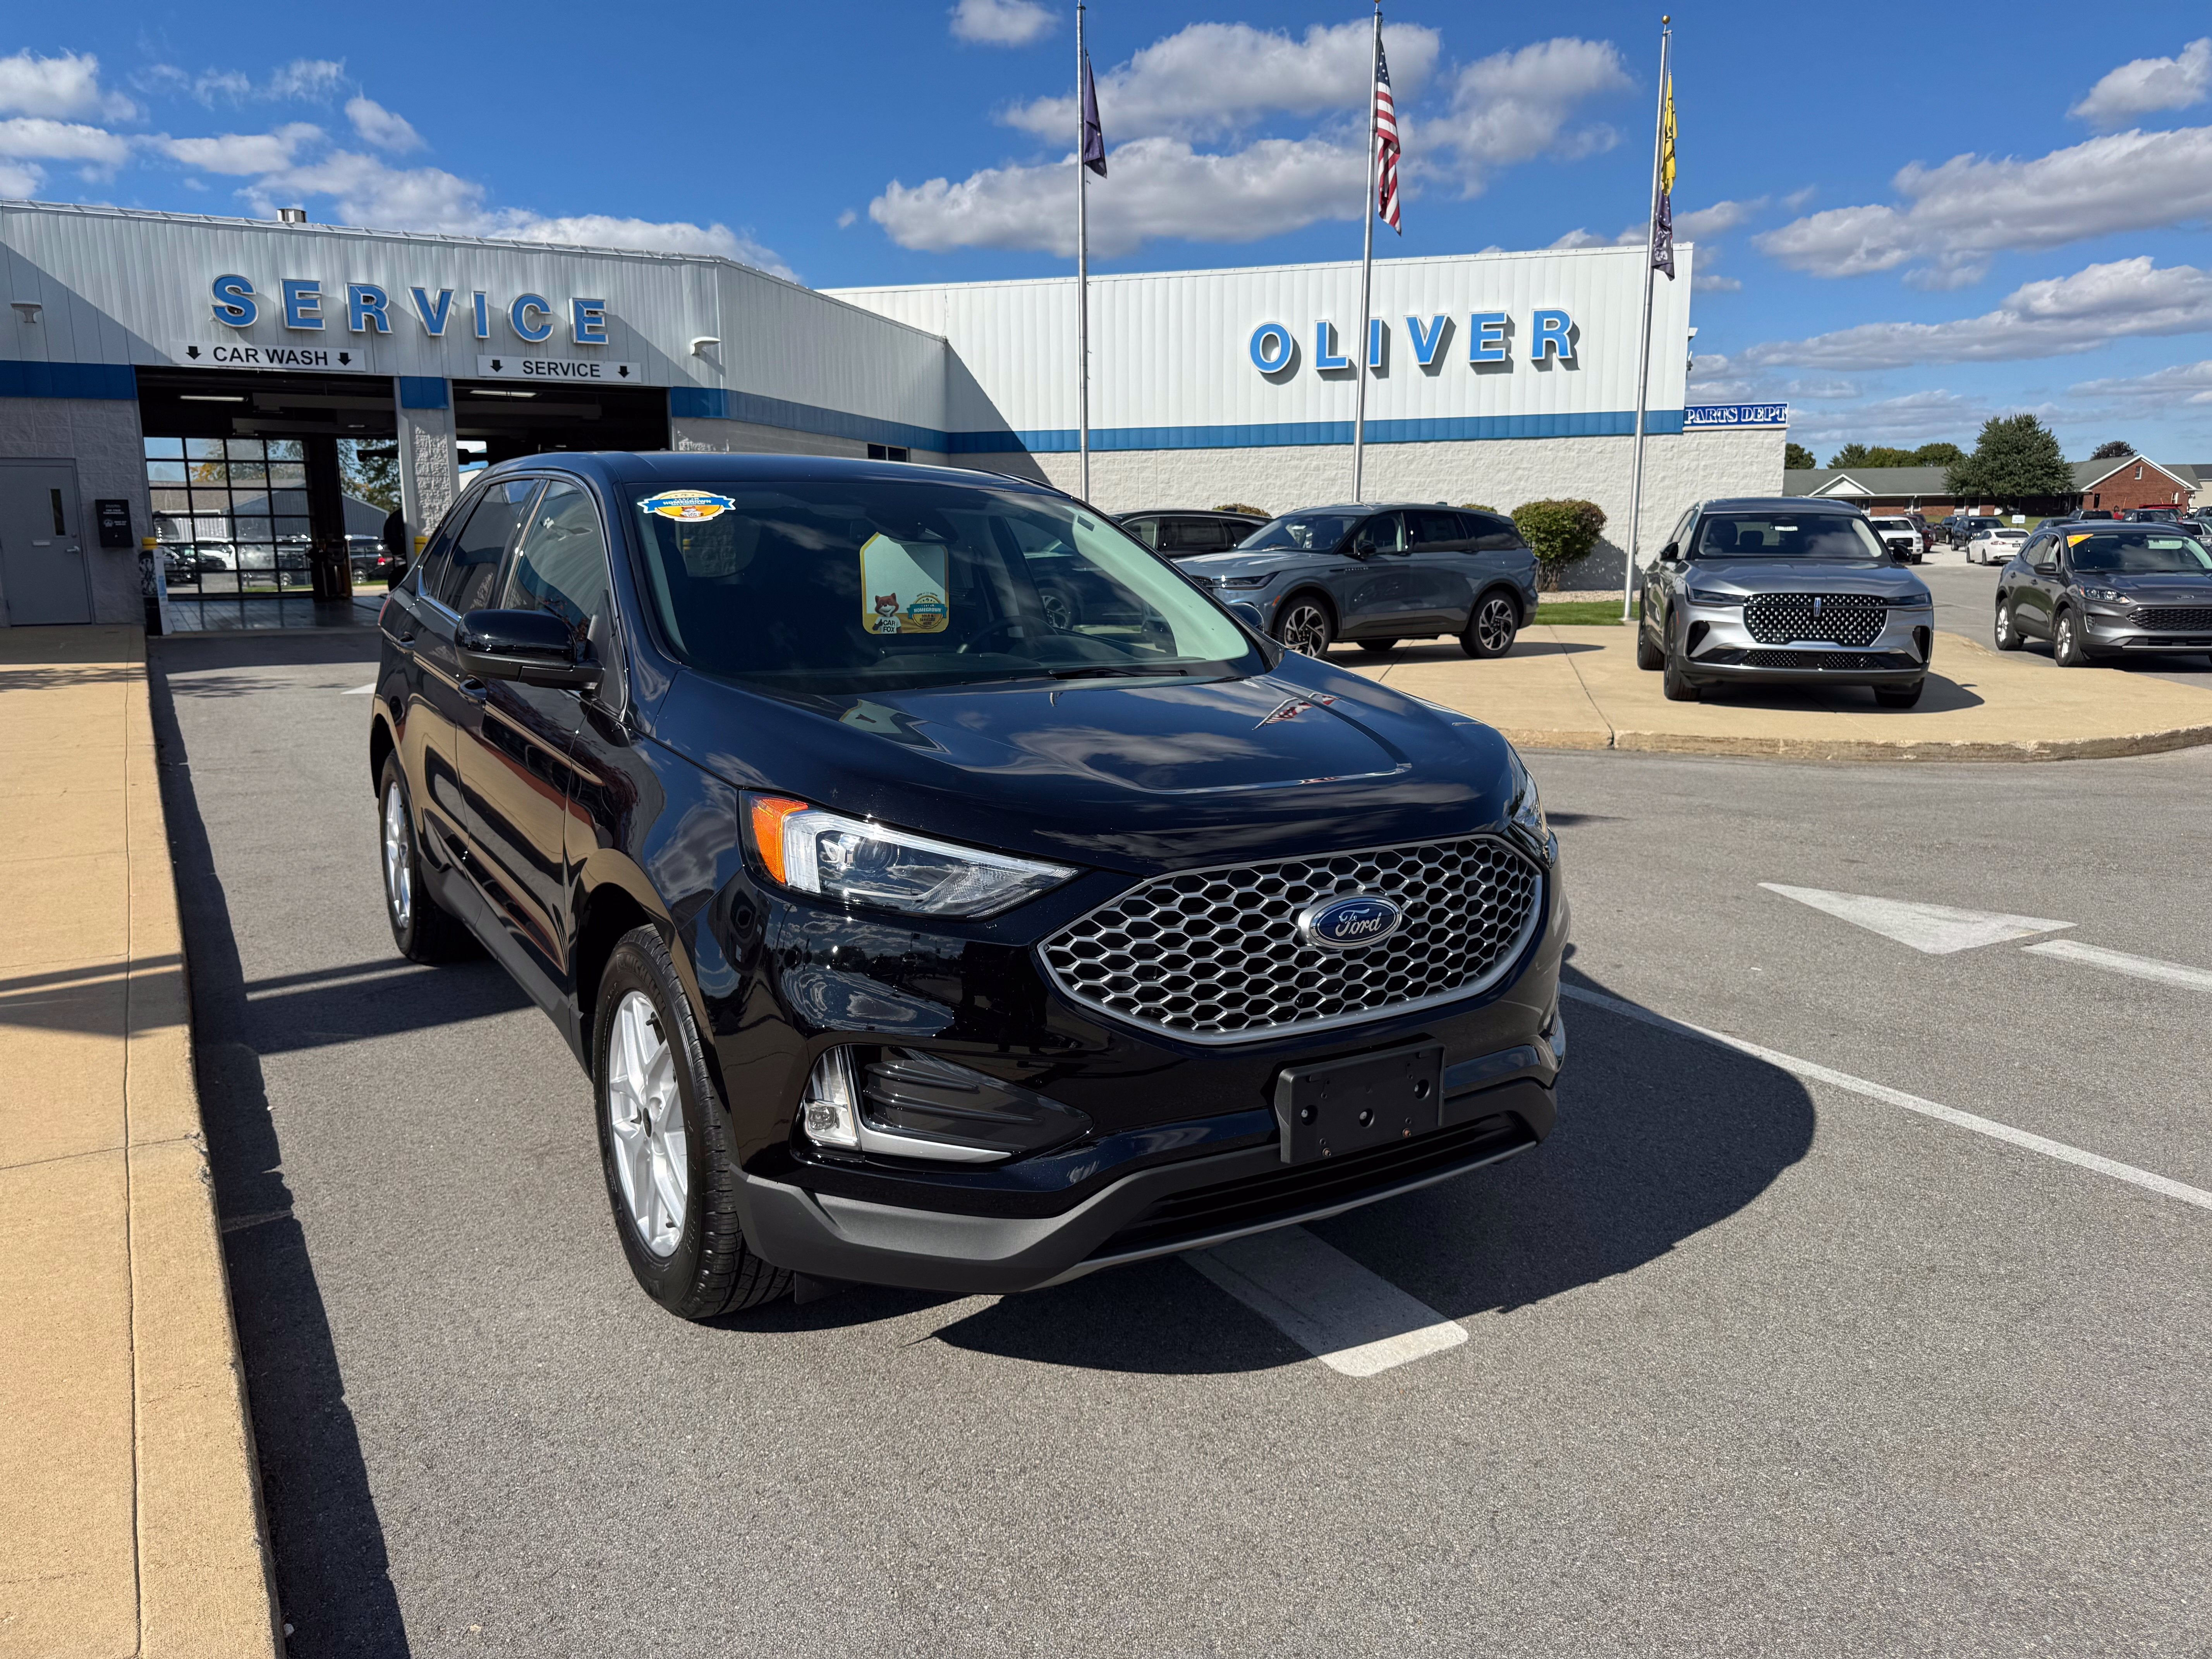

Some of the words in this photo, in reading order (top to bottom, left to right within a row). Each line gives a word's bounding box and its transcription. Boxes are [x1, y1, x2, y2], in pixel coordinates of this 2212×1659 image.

[211, 274, 609, 345] SERVICE
[1249, 308, 1573, 374] OLIVER
[213, 347, 260, 363] CAR
[265, 349, 328, 366] WASH
[523, 361, 601, 377] SERVICE
[1684, 407, 1738, 424] PARTS
[1741, 406, 1787, 422] DEPT
[1335, 908, 1382, 937] Ford
